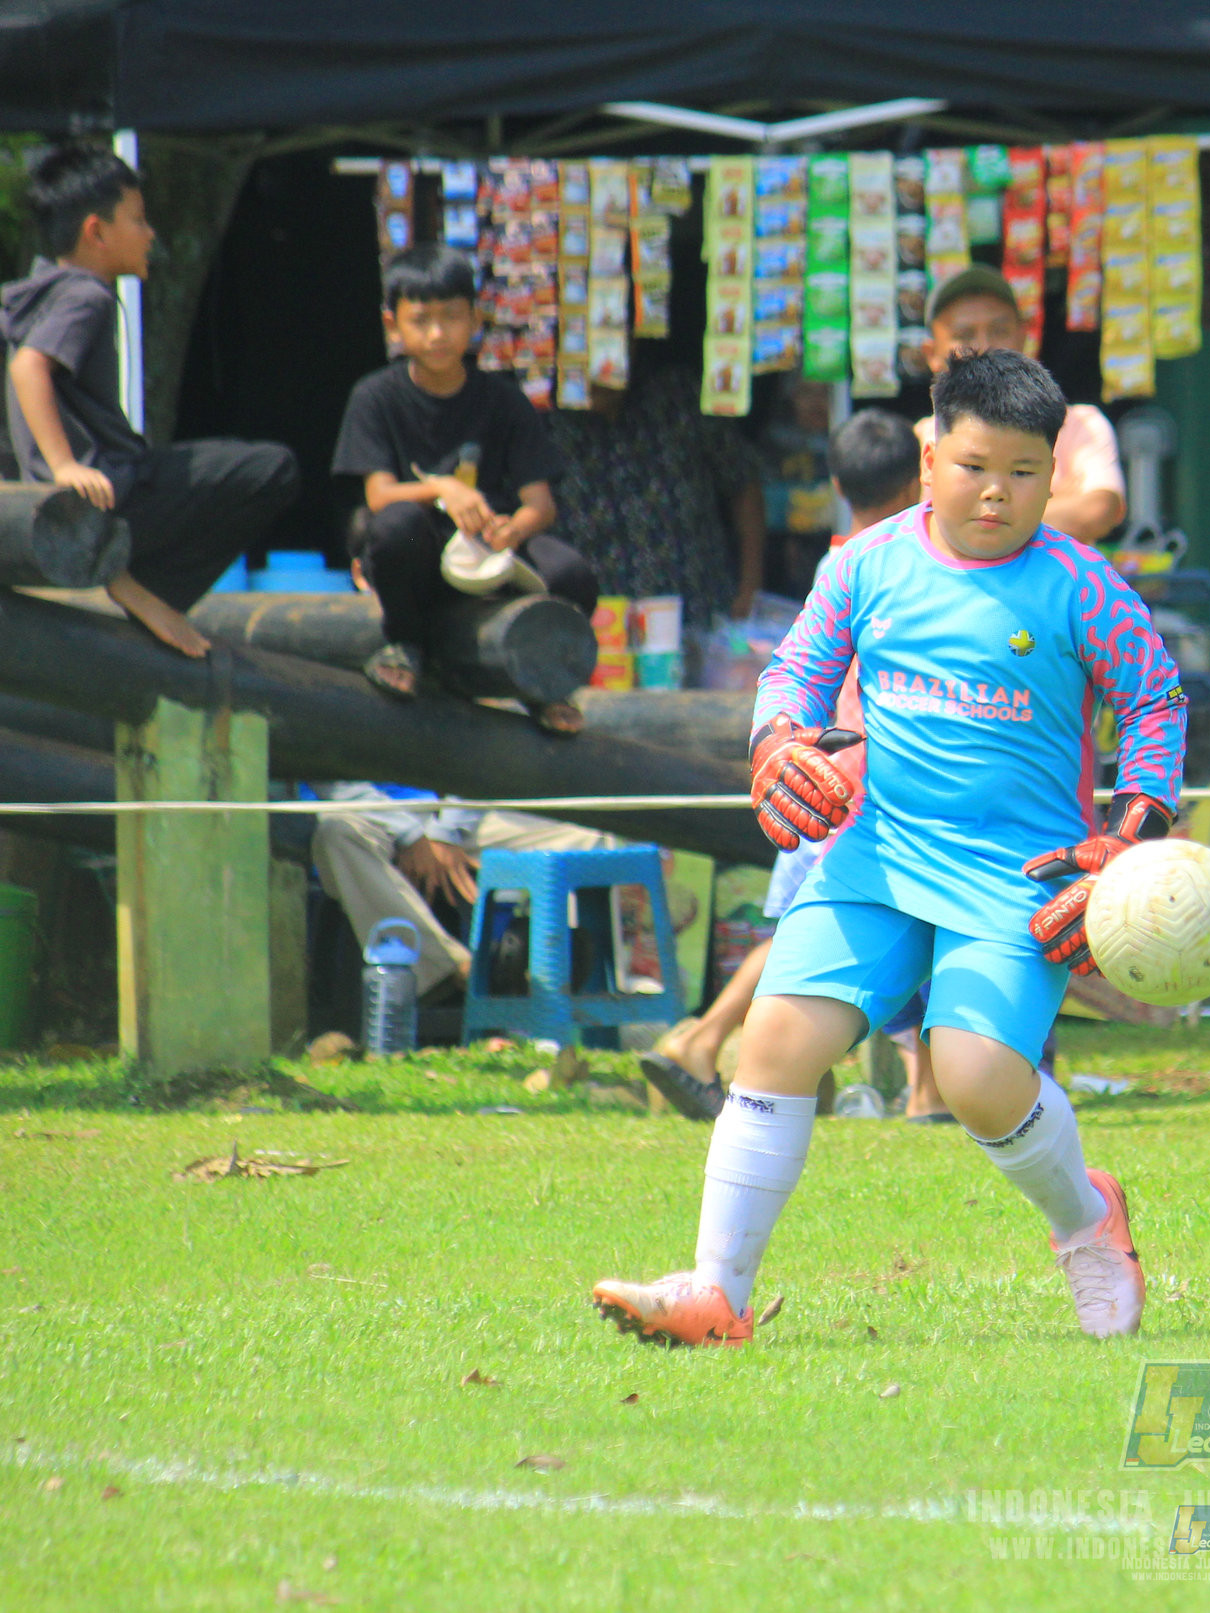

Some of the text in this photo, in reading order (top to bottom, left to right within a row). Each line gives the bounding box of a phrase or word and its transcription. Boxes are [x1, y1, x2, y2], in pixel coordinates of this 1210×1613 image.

[876, 691, 1033, 722] SOCCER SCHOOLS
[877, 670, 1031, 707] BRAZILIAN
[1041, 890, 1087, 931] PINTO
